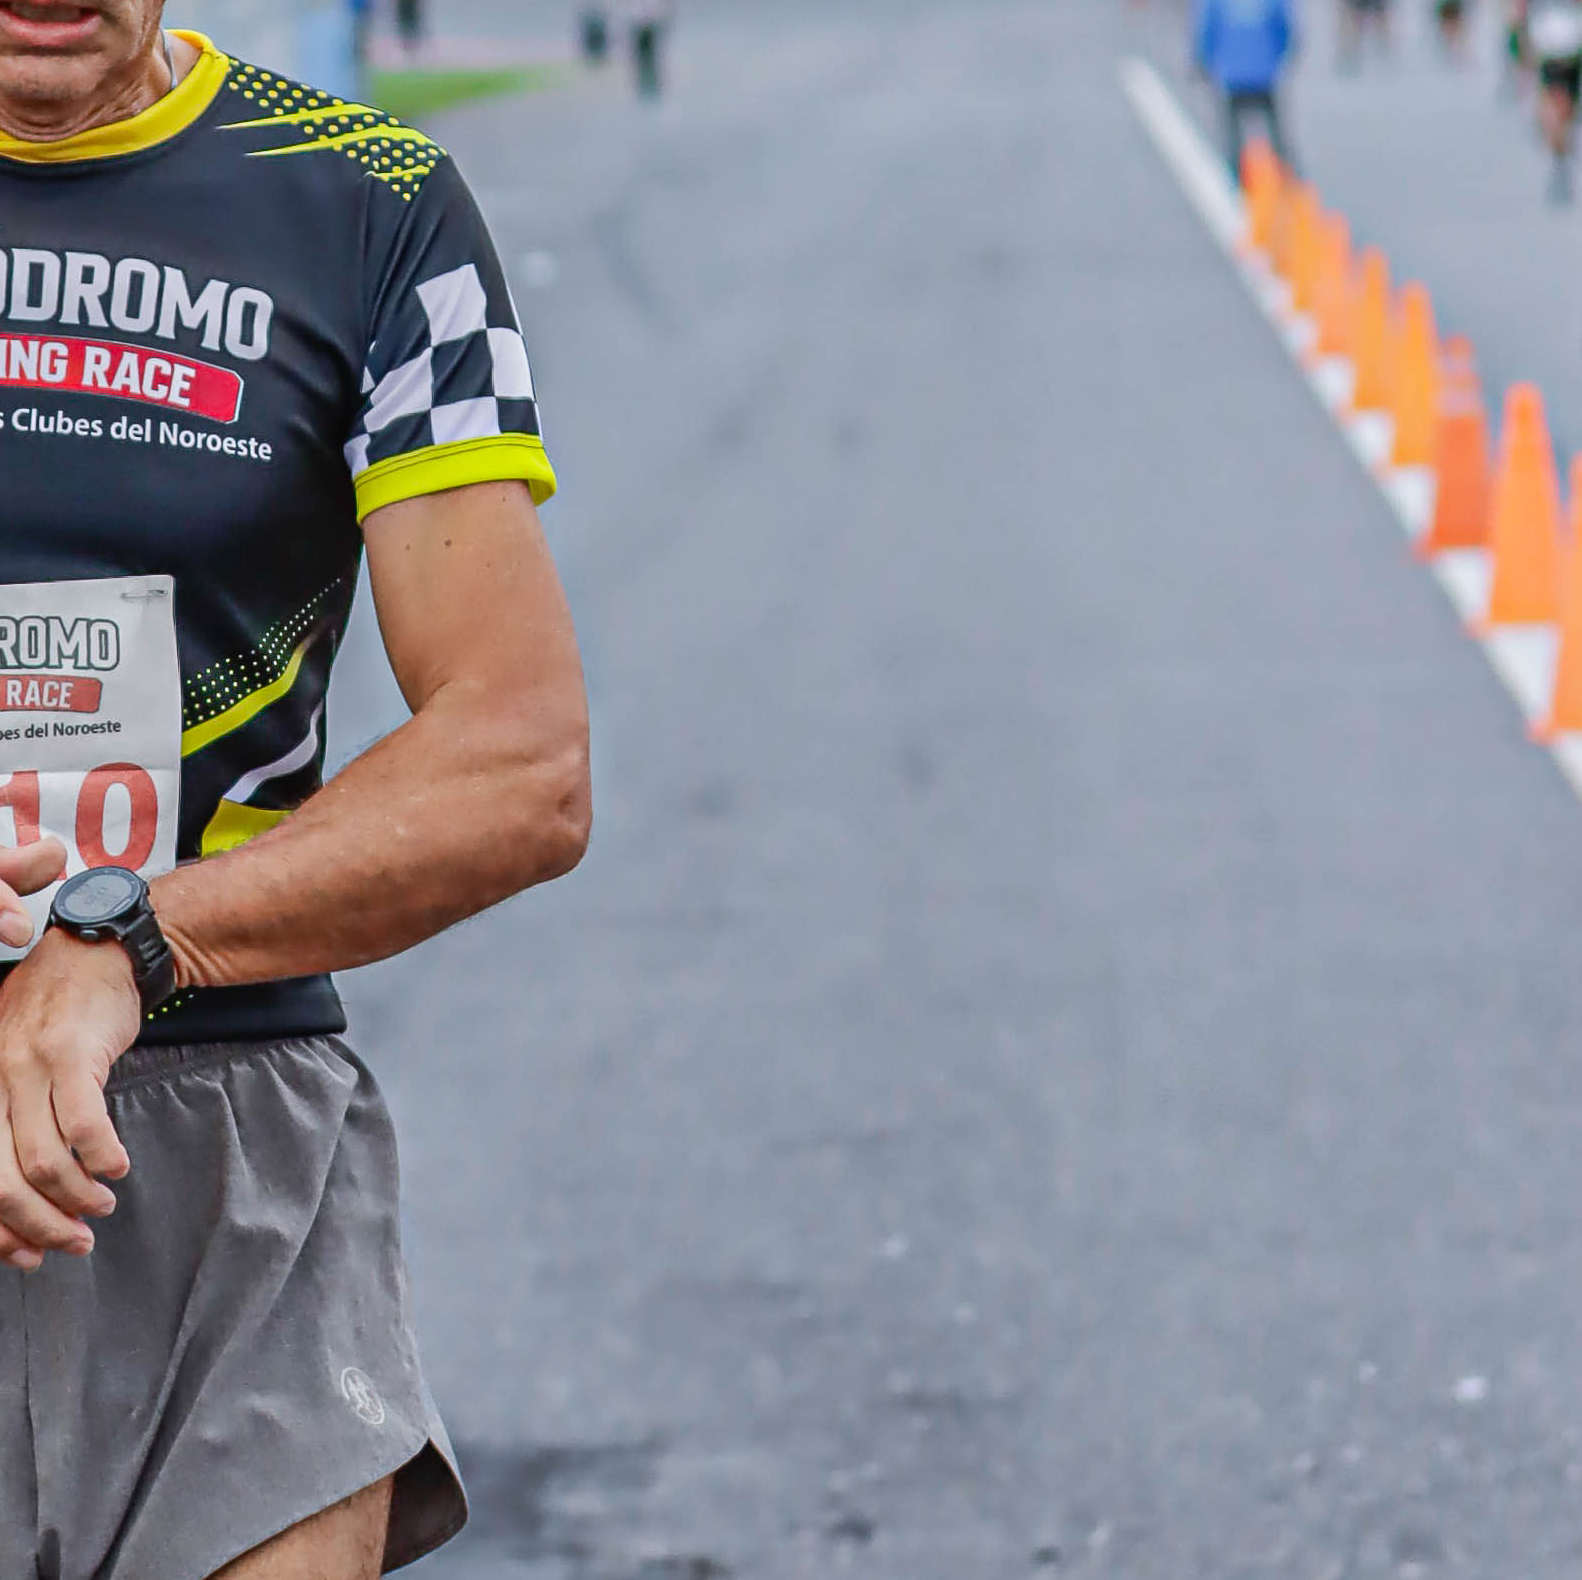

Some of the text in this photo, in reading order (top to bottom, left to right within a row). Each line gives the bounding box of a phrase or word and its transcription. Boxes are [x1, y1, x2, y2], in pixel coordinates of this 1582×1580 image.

[81, 351, 196, 408] RACE
[12, 408, 102, 438] Clubes
[111, 414, 151, 443] del
[159, 423, 272, 461] Noroeste
[6, 680, 74, 708] RACE
[25, 722, 48, 740] del
[52, 719, 121, 737] Noroeste
